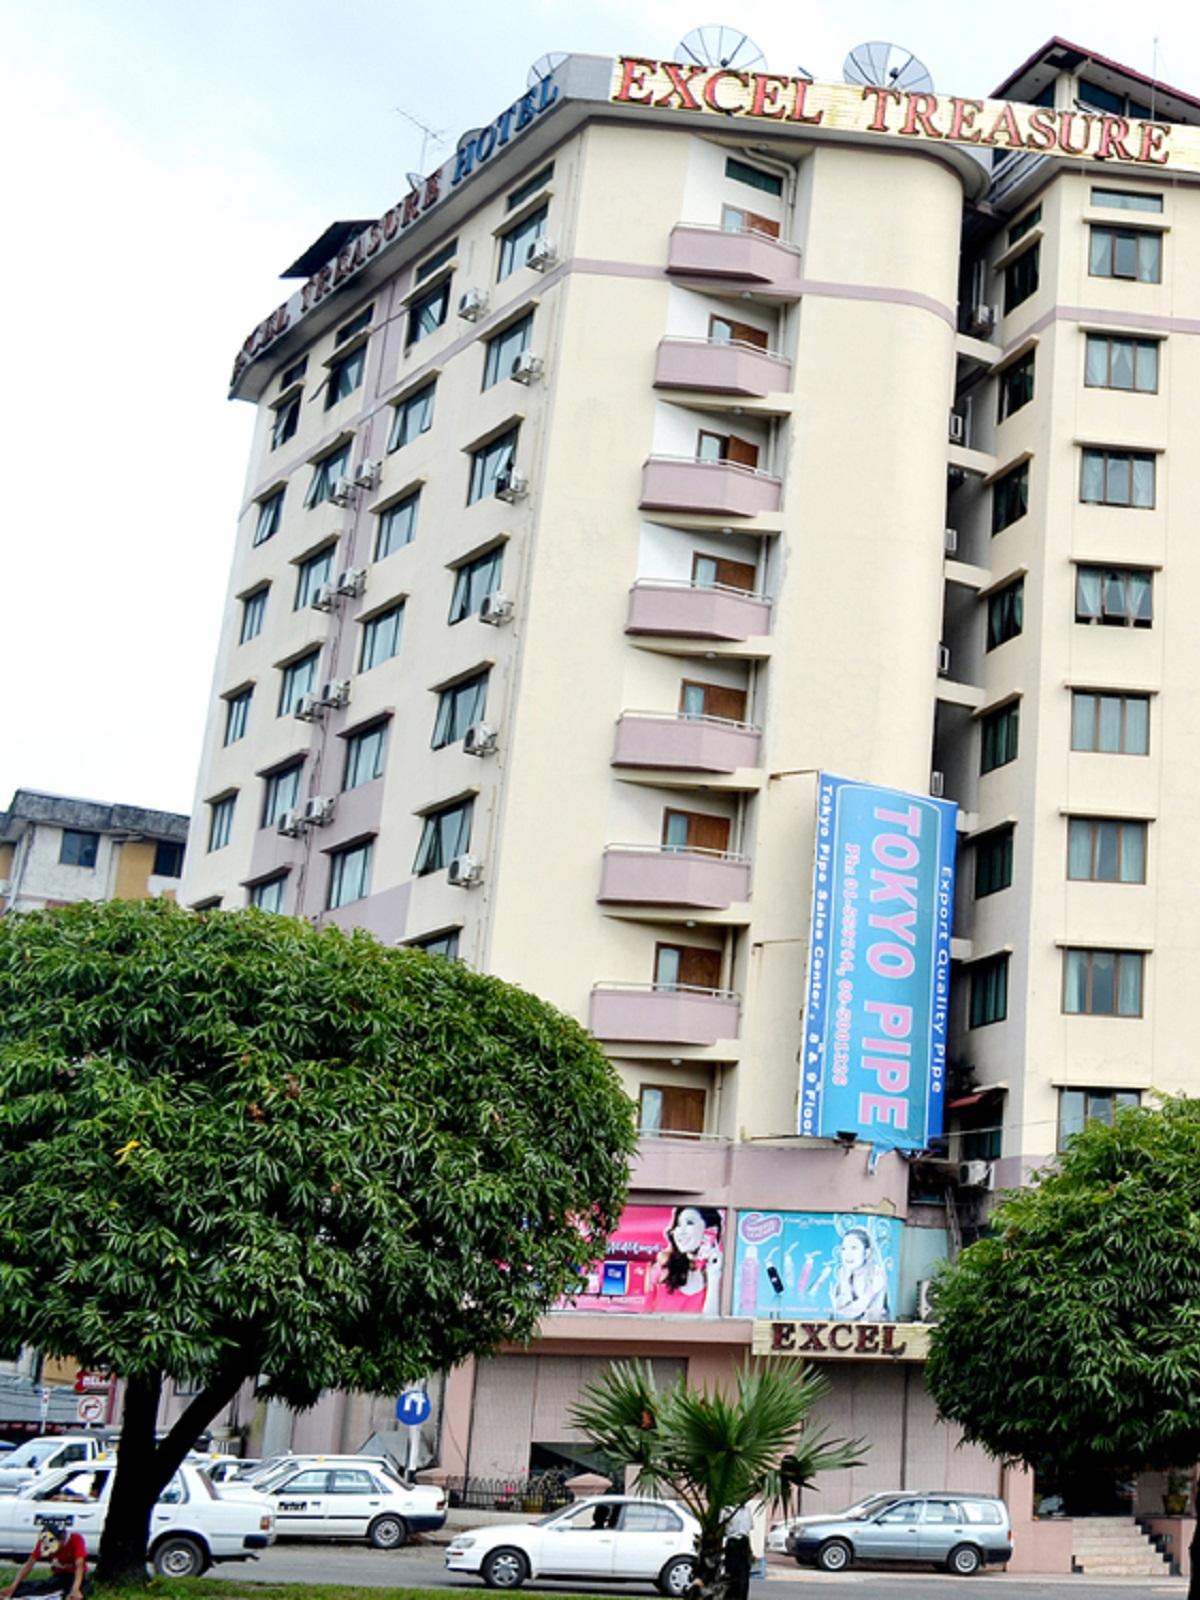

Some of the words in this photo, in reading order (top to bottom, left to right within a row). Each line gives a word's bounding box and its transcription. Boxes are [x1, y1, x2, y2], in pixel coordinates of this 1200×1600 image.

[451, 75, 559, 187] HOTEL
[613, 55, 824, 125] EXCEL
[861, 86, 1172, 165] TREASURE
[818, 784, 833, 837] Tokyo
[816, 843, 830, 882] Pipe
[866, 804, 922, 979] TOKYO
[814, 890, 828, 940] Sales
[938, 866, 953, 940] Export
[933, 949, 950, 1035] Quality
[858, 1000, 913, 1130] PIPE
[931, 1043, 945, 1093] Pipe
[770, 1321, 907, 1356] EXCEL
